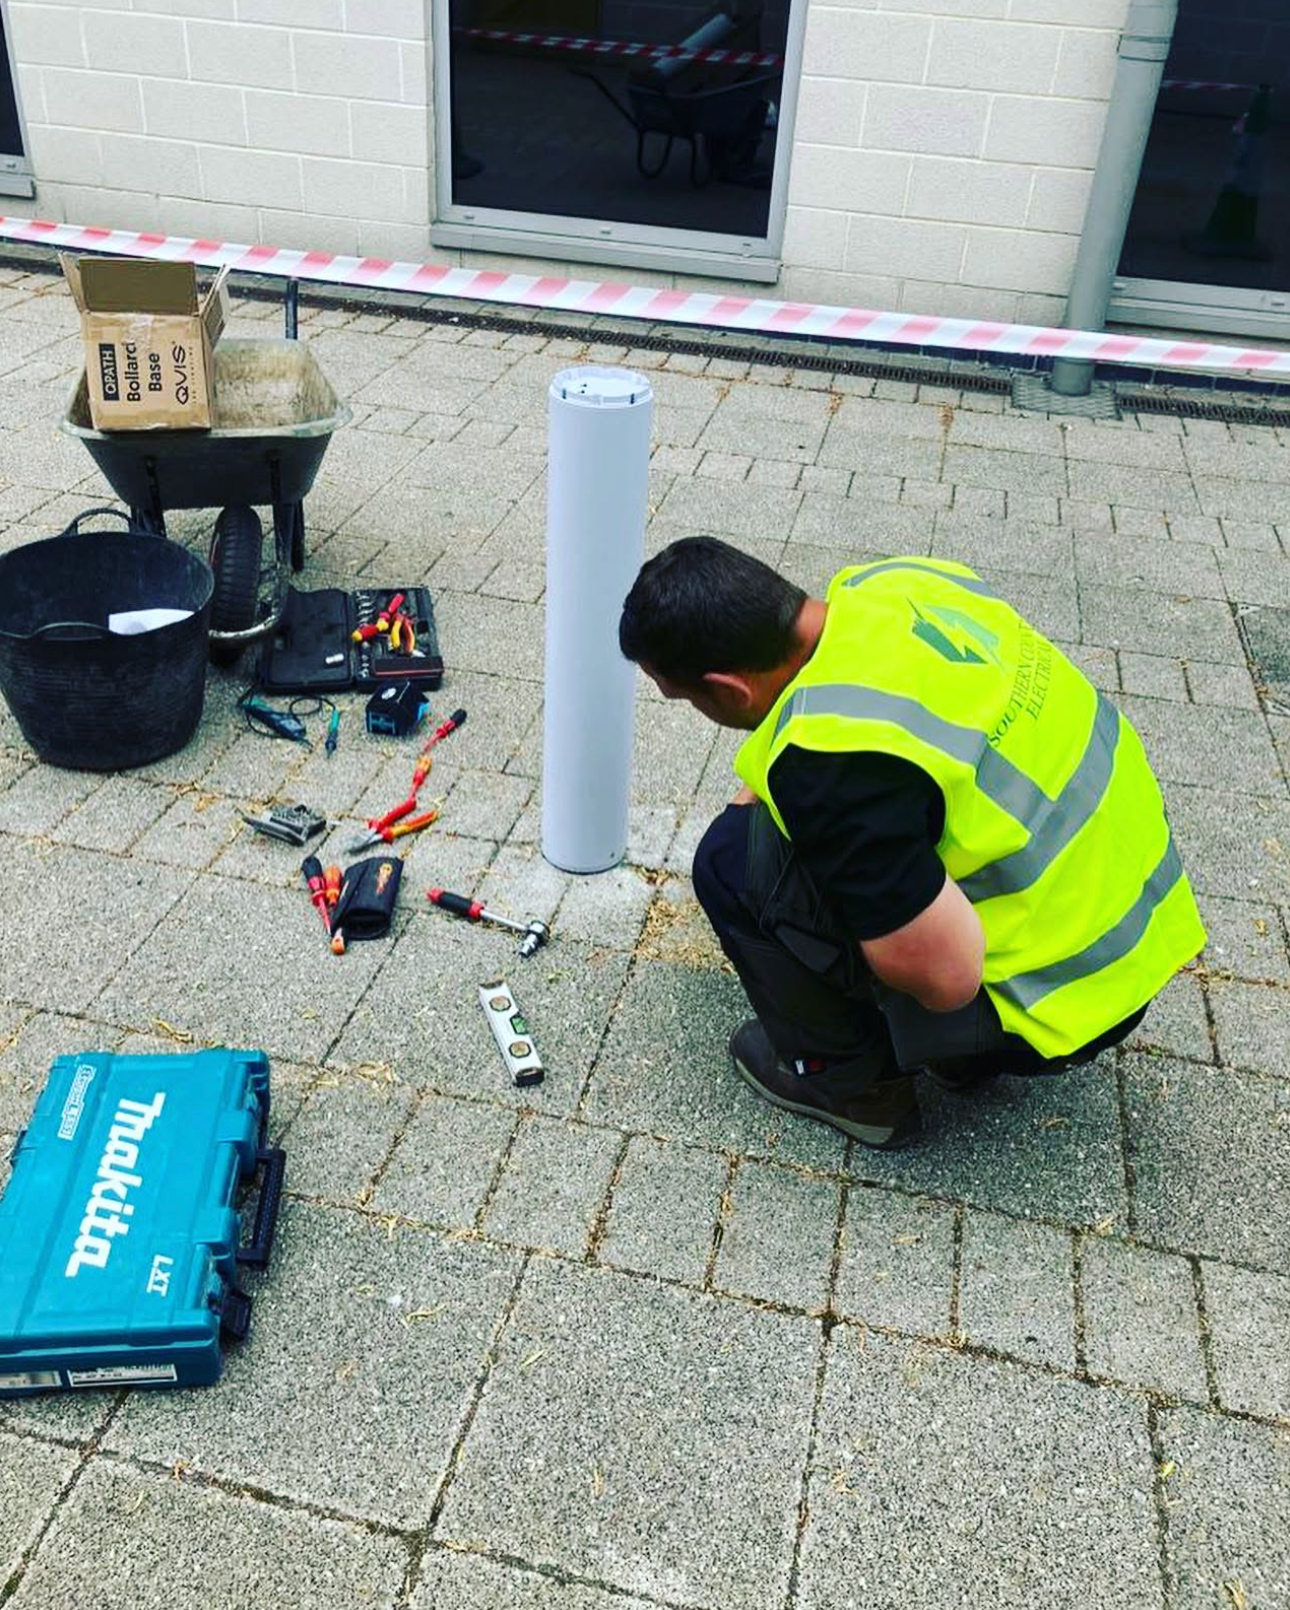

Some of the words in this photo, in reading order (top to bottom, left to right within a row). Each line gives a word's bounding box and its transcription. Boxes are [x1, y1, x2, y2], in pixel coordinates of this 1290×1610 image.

[121, 342, 141, 402] Bollard
[148, 352, 163, 392] Base
[172, 344, 189, 405] QVIS
[989, 660, 1032, 747] SOUTHERN
[146, 1254, 174, 1297] LXT
